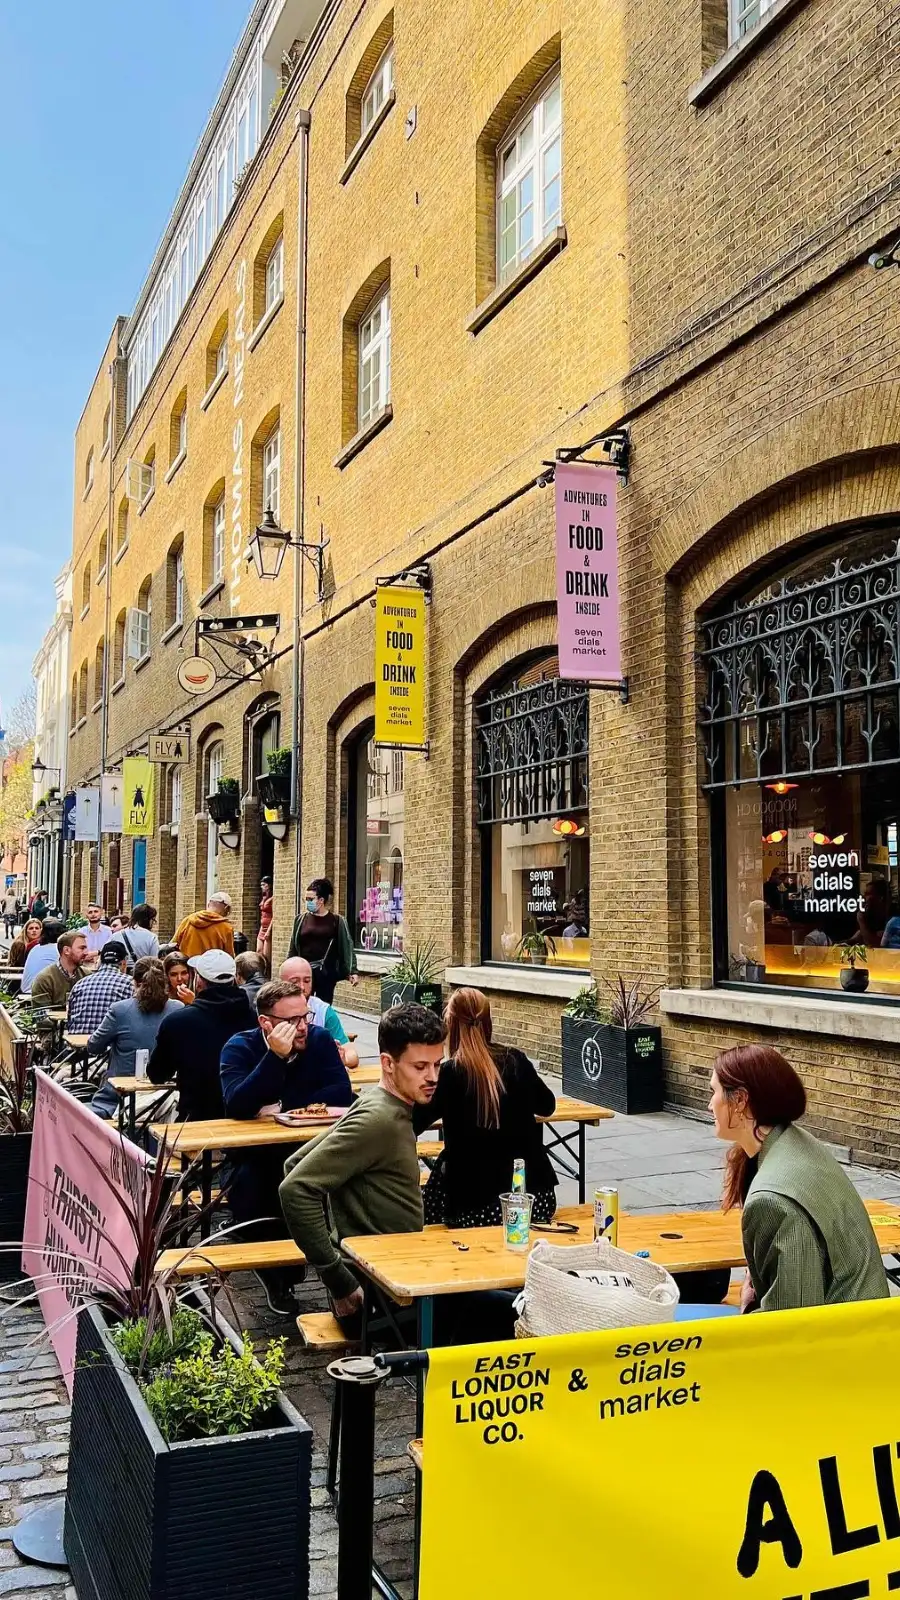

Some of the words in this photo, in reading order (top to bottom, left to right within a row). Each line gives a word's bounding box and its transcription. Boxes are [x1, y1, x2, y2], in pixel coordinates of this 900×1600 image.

[233, 259, 247, 408] NEALS
[564, 490, 607, 507] ADVENTURES
[230, 419, 243, 614] THOMAS
[582, 510, 590, 522] IN
[569, 525, 603, 551] FOOD
[584, 555, 590, 567] &
[565, 571, 609, 598] DRINK
[383, 605, 417, 619] ADVENTURES
[575, 602, 600, 616] INSIDE
[397, 620, 404, 629] IN
[574, 628, 603, 637] seven
[386, 631, 413, 650] FOOD
[578, 637, 600, 646] dials
[397, 652, 402, 662] &
[572, 646, 607, 656] market
[382, 664, 416, 684] DRINK
[389, 686, 409, 697] INSIDE
[155, 741, 172, 755] FLY
[129, 811, 147, 825] FLY
[808, 852, 859, 868] seven
[529, 870, 554, 882] seven
[813, 872, 853, 891] dials
[532, 882, 551, 897] dials
[527, 900, 557, 912] market
[804, 895, 866, 913] market
[614, 1335, 703, 1359] seven
[474, 1352, 536, 1373] EAST
[567, 1368, 589, 1392] &
[619, 1358, 686, 1385] dials
[451, 1369, 550, 1399] LONDON
[455, 1392, 544, 1424] LIQUOR
[599, 1381, 701, 1419] market
[483, 1422, 524, 1445] CO.
[737, 1469, 803, 1579] A
[818, 1441, 900, 1556] LI
